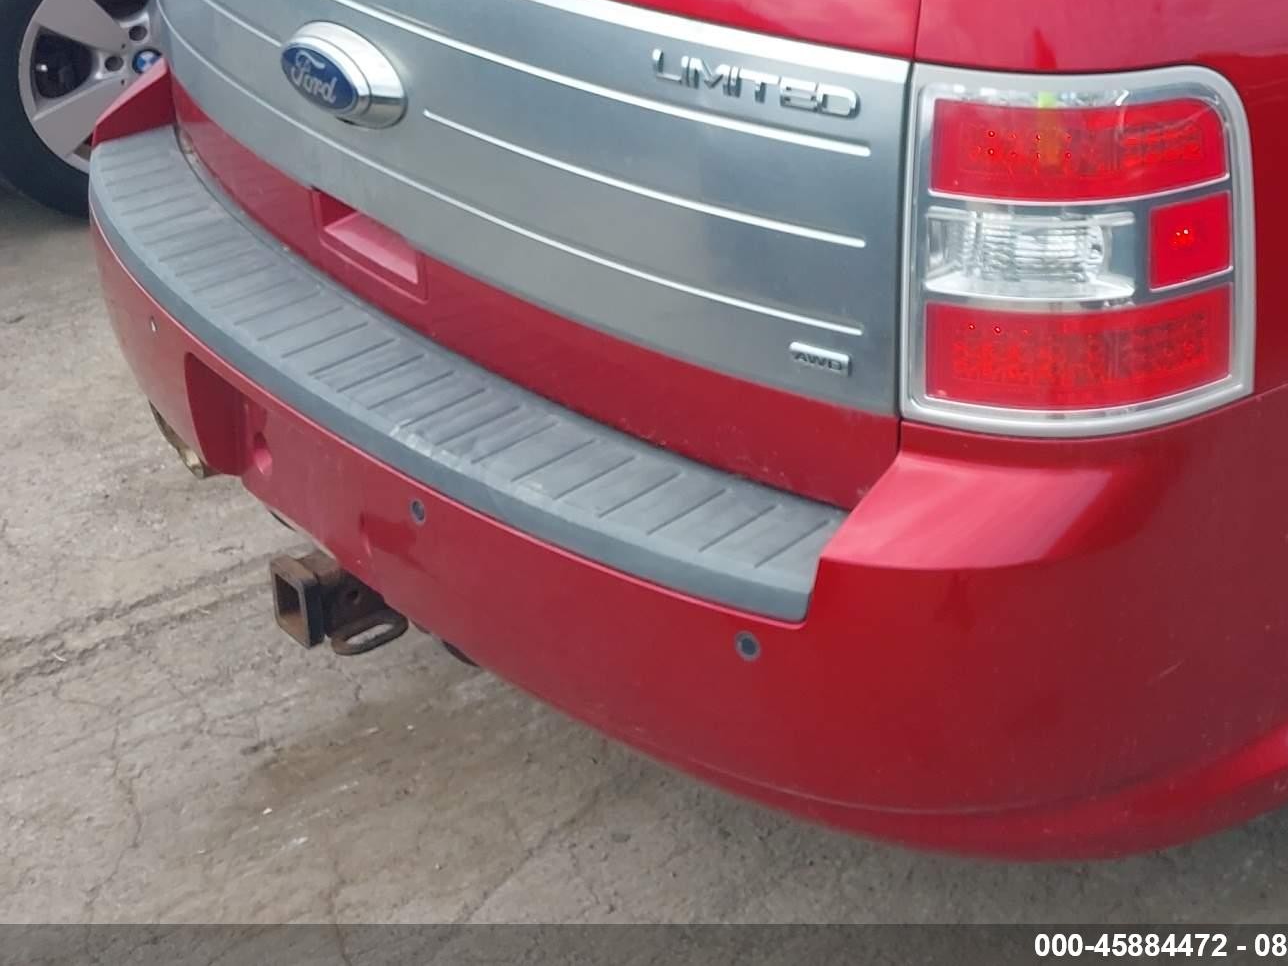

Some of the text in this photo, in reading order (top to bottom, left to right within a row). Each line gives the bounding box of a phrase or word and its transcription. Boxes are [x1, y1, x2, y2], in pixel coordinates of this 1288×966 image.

[290, 50, 338, 105] Ford
[651, 48, 861, 120] LIMITED
[794, 352, 844, 372] AWD
